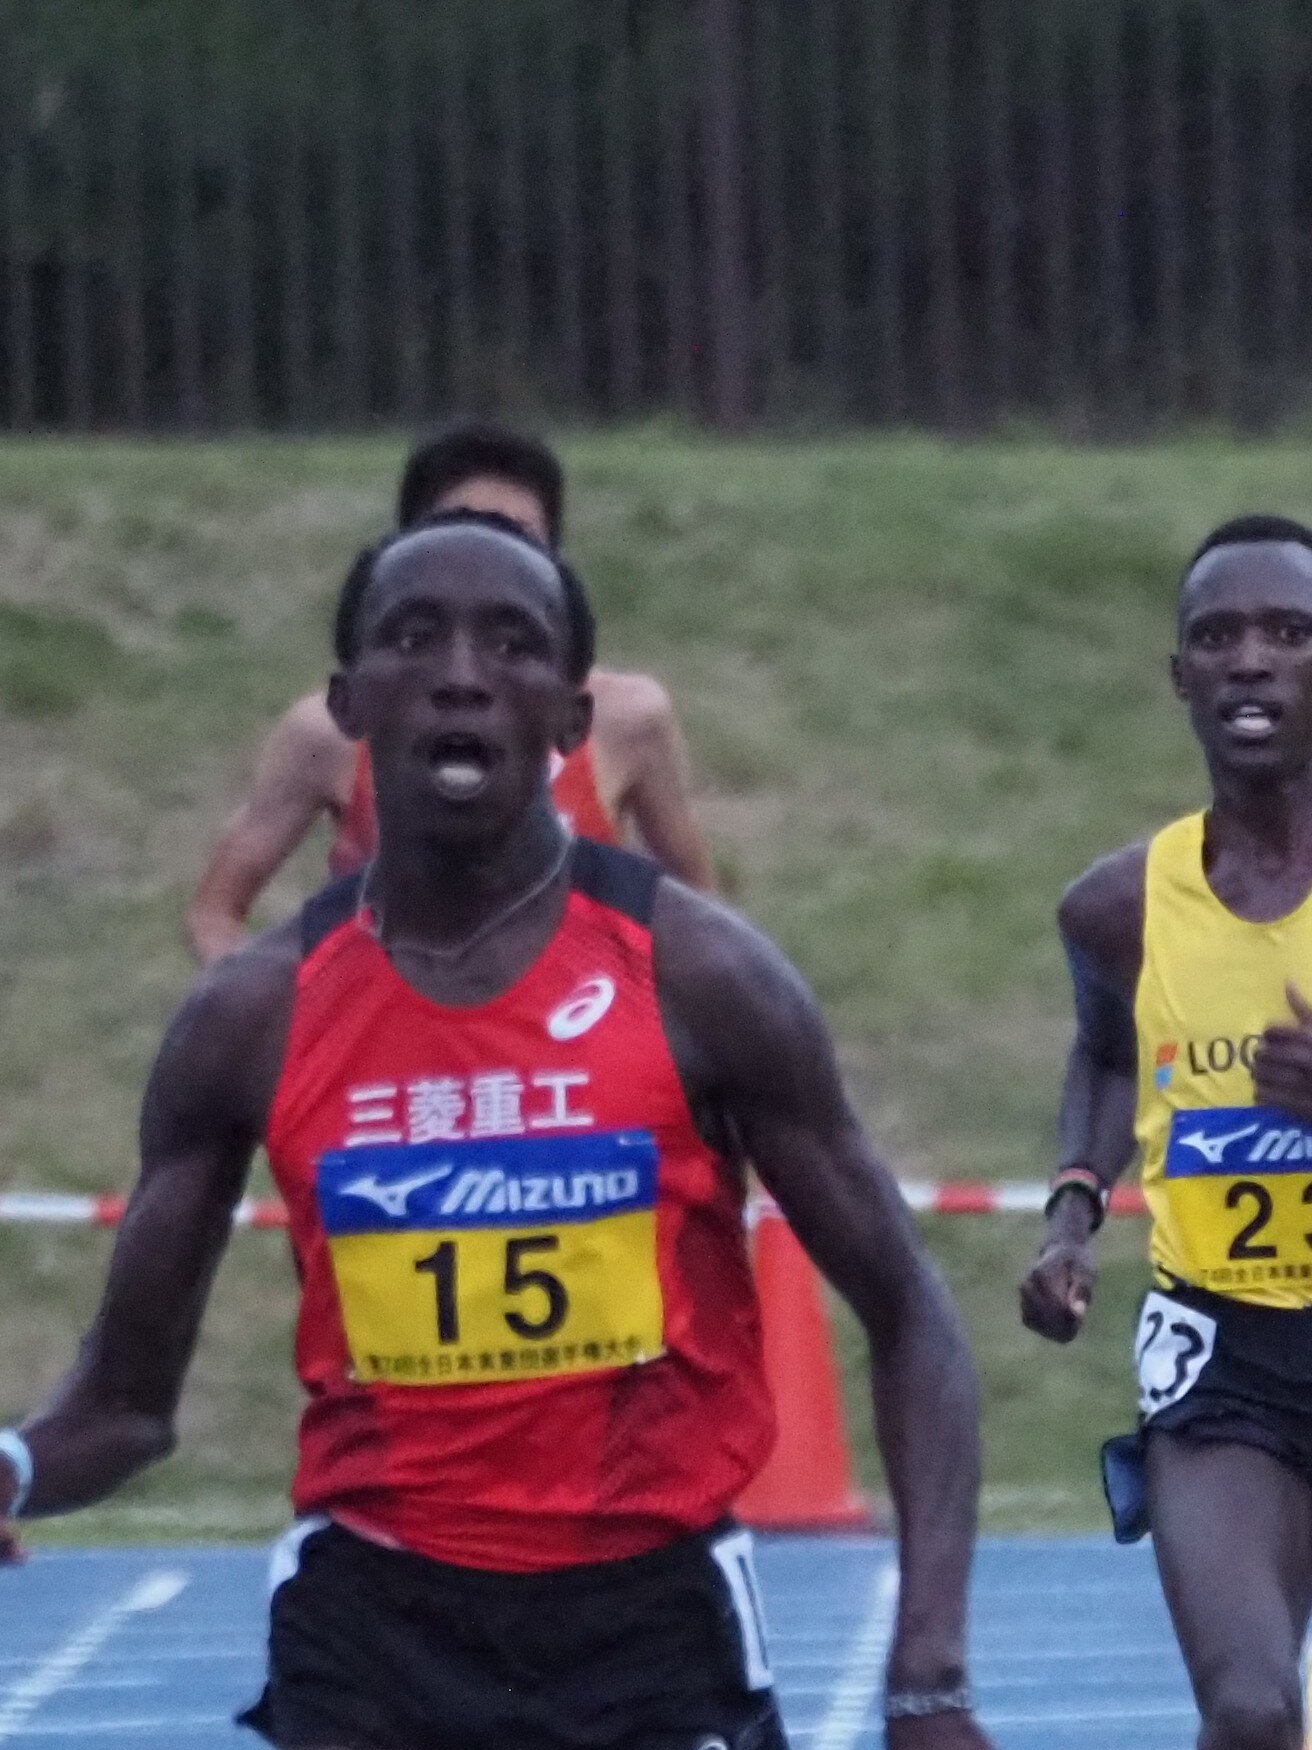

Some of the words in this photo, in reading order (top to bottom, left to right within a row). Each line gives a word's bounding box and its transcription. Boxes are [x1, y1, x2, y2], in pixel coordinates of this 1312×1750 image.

[345, 1071, 594, 1147] 三菱重工
[414, 1234, 570, 1346] 15
